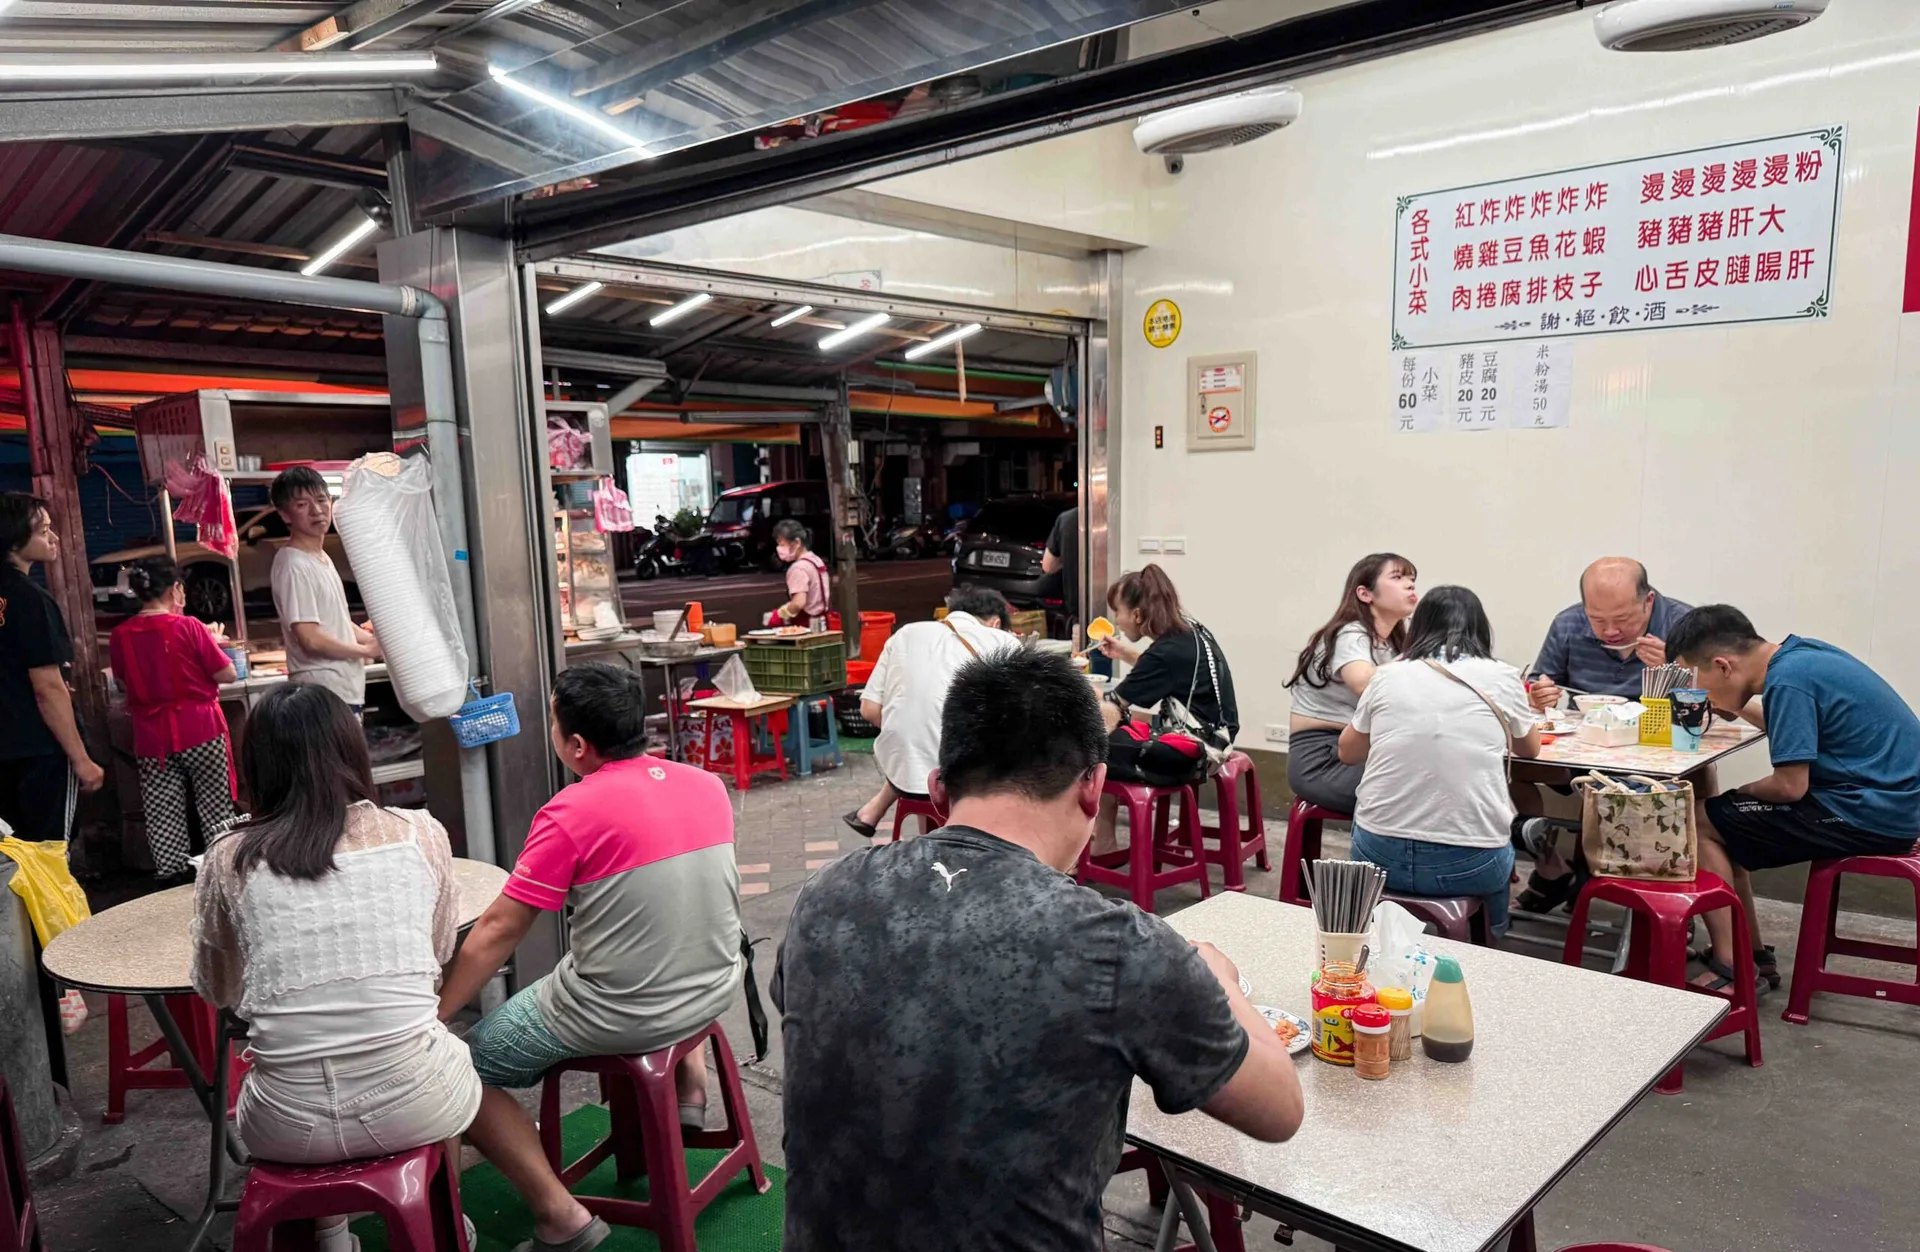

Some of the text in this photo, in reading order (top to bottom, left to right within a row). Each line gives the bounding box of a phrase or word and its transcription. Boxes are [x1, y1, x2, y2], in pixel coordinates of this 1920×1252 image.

[1407, 208, 1431, 315] 各式小菜
[1421, 367, 1439, 402] 小菜
